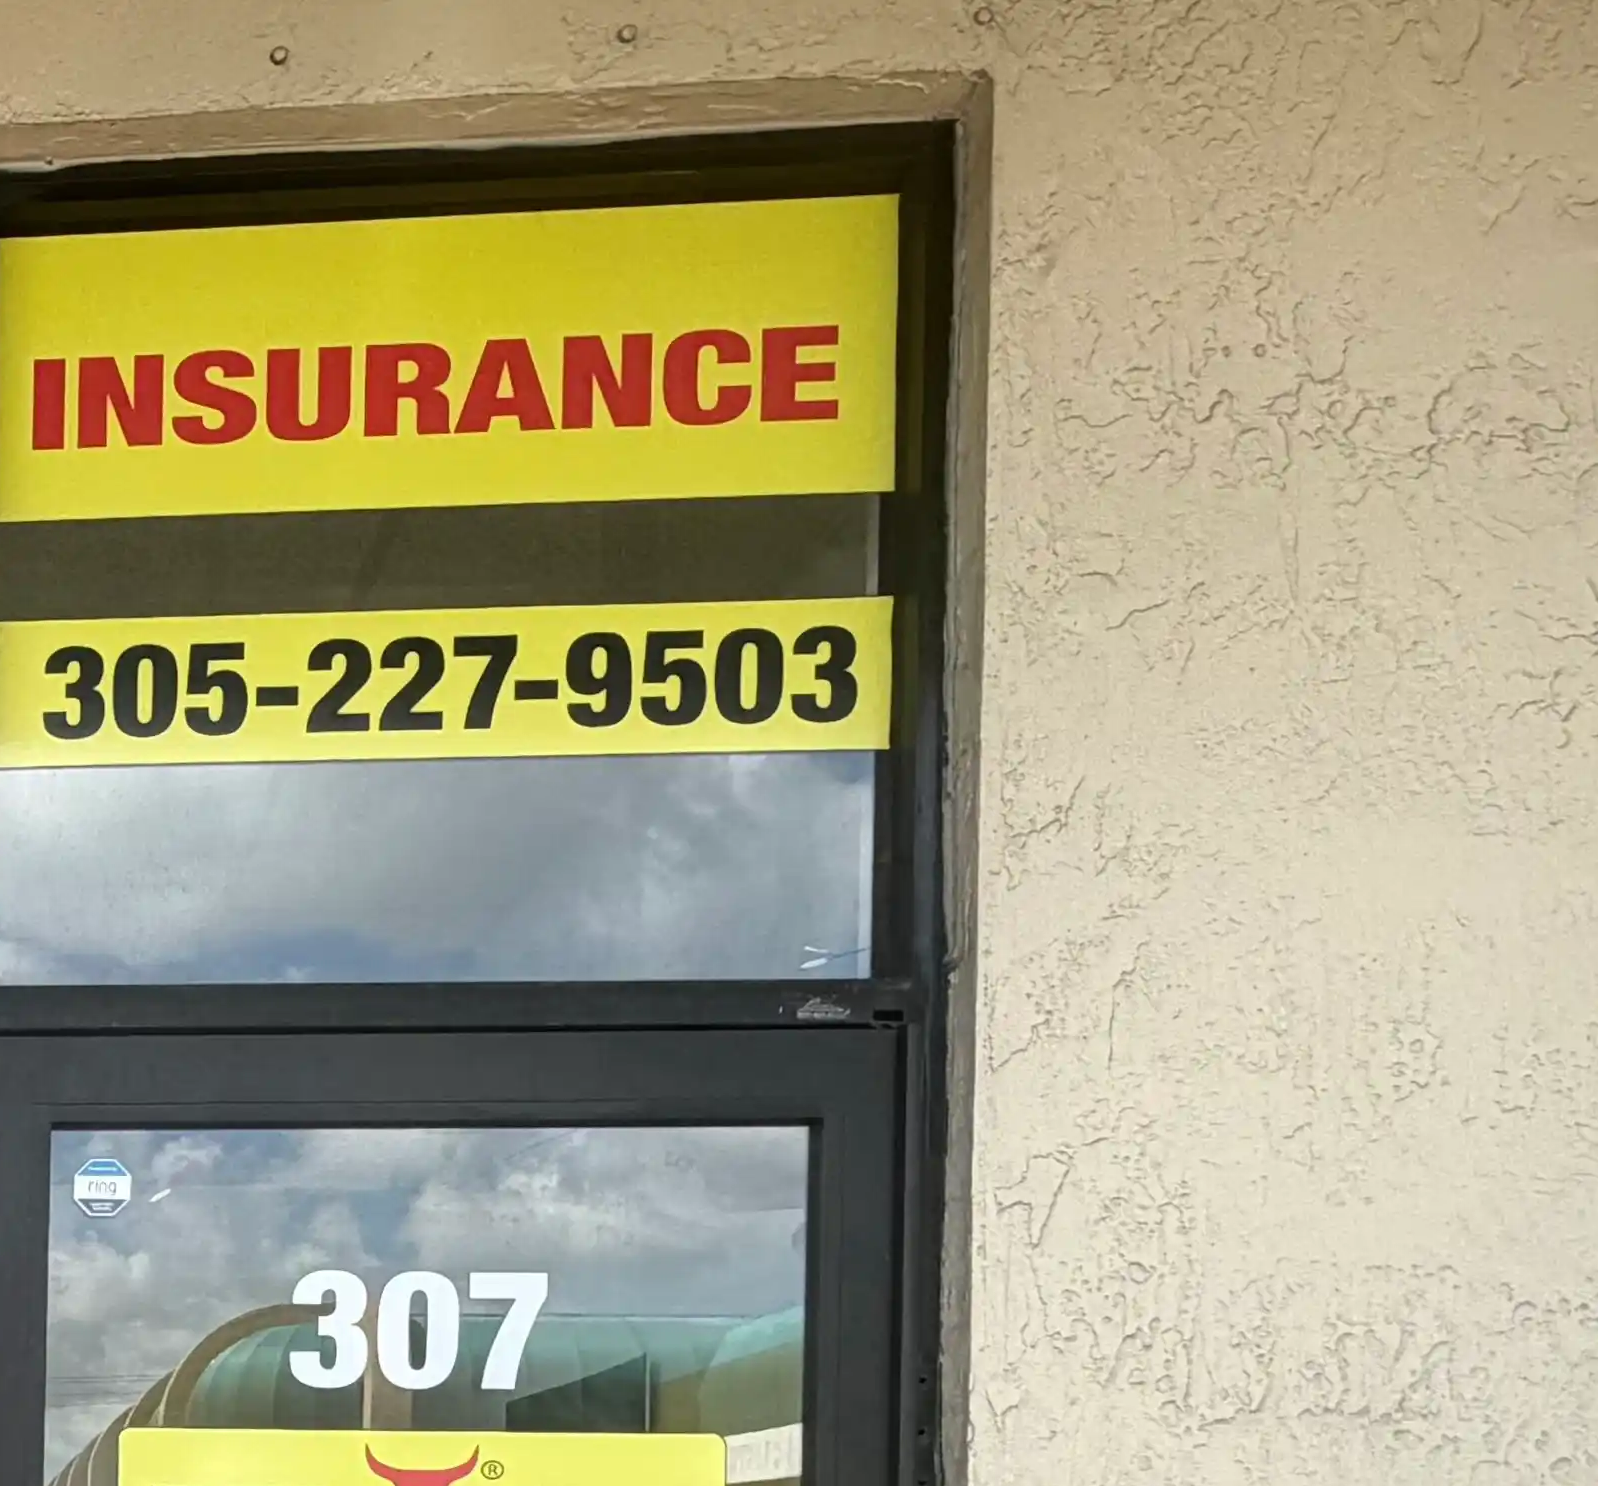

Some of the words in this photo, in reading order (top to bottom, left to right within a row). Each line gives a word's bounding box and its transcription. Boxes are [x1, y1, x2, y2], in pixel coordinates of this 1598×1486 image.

[32, 325, 840, 451] INSURANCE
[42, 626, 859, 740] 305-227-9503
[88, 1180, 117, 1195] ring
[287, 1270, 550, 1391] 307
